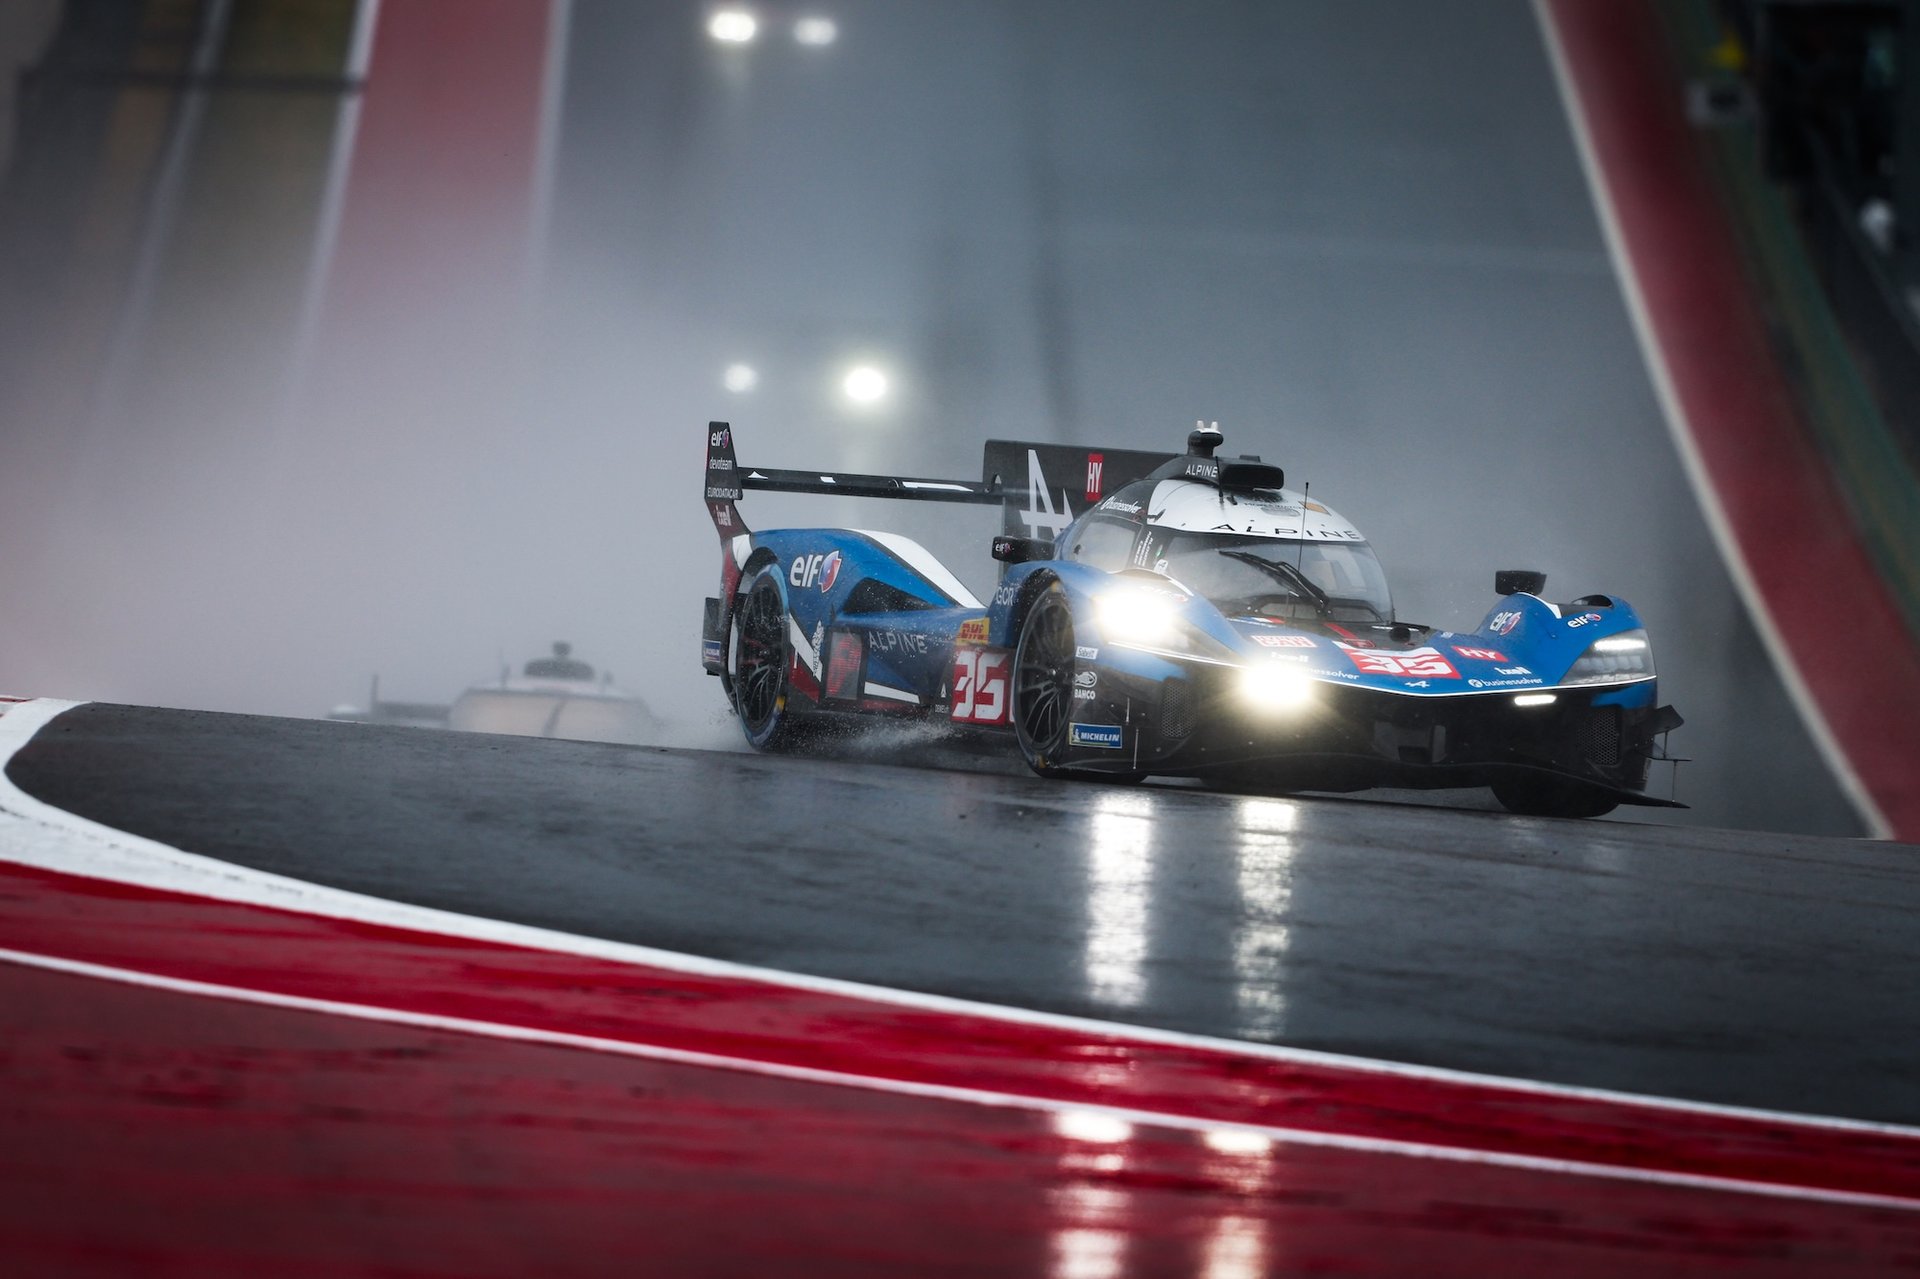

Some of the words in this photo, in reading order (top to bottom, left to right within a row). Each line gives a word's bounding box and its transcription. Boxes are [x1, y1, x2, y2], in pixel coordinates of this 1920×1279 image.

[711, 431, 723, 447] elf
[709, 456, 733, 471] devoteam
[1184, 463, 1219, 478] ALPINE
[1086, 462, 1102, 493] HY
[707, 486, 739, 499] EURODATACAR
[1210, 523, 1360, 540] ALPINE
[790, 554, 823, 588] elf
[1489, 611, 1513, 632] elf
[1567, 614, 1588, 629] elf
[868, 631, 928, 654] ALPINE
[1458, 647, 1497, 660] HY
[1350, 651, 1453, 676] 35
[952, 650, 1007, 720] 35
[1482, 677, 1543, 687] businessolver
[1074, 688, 1096, 700] BAHCO
[1080, 731, 1121, 742] MICHELIN
